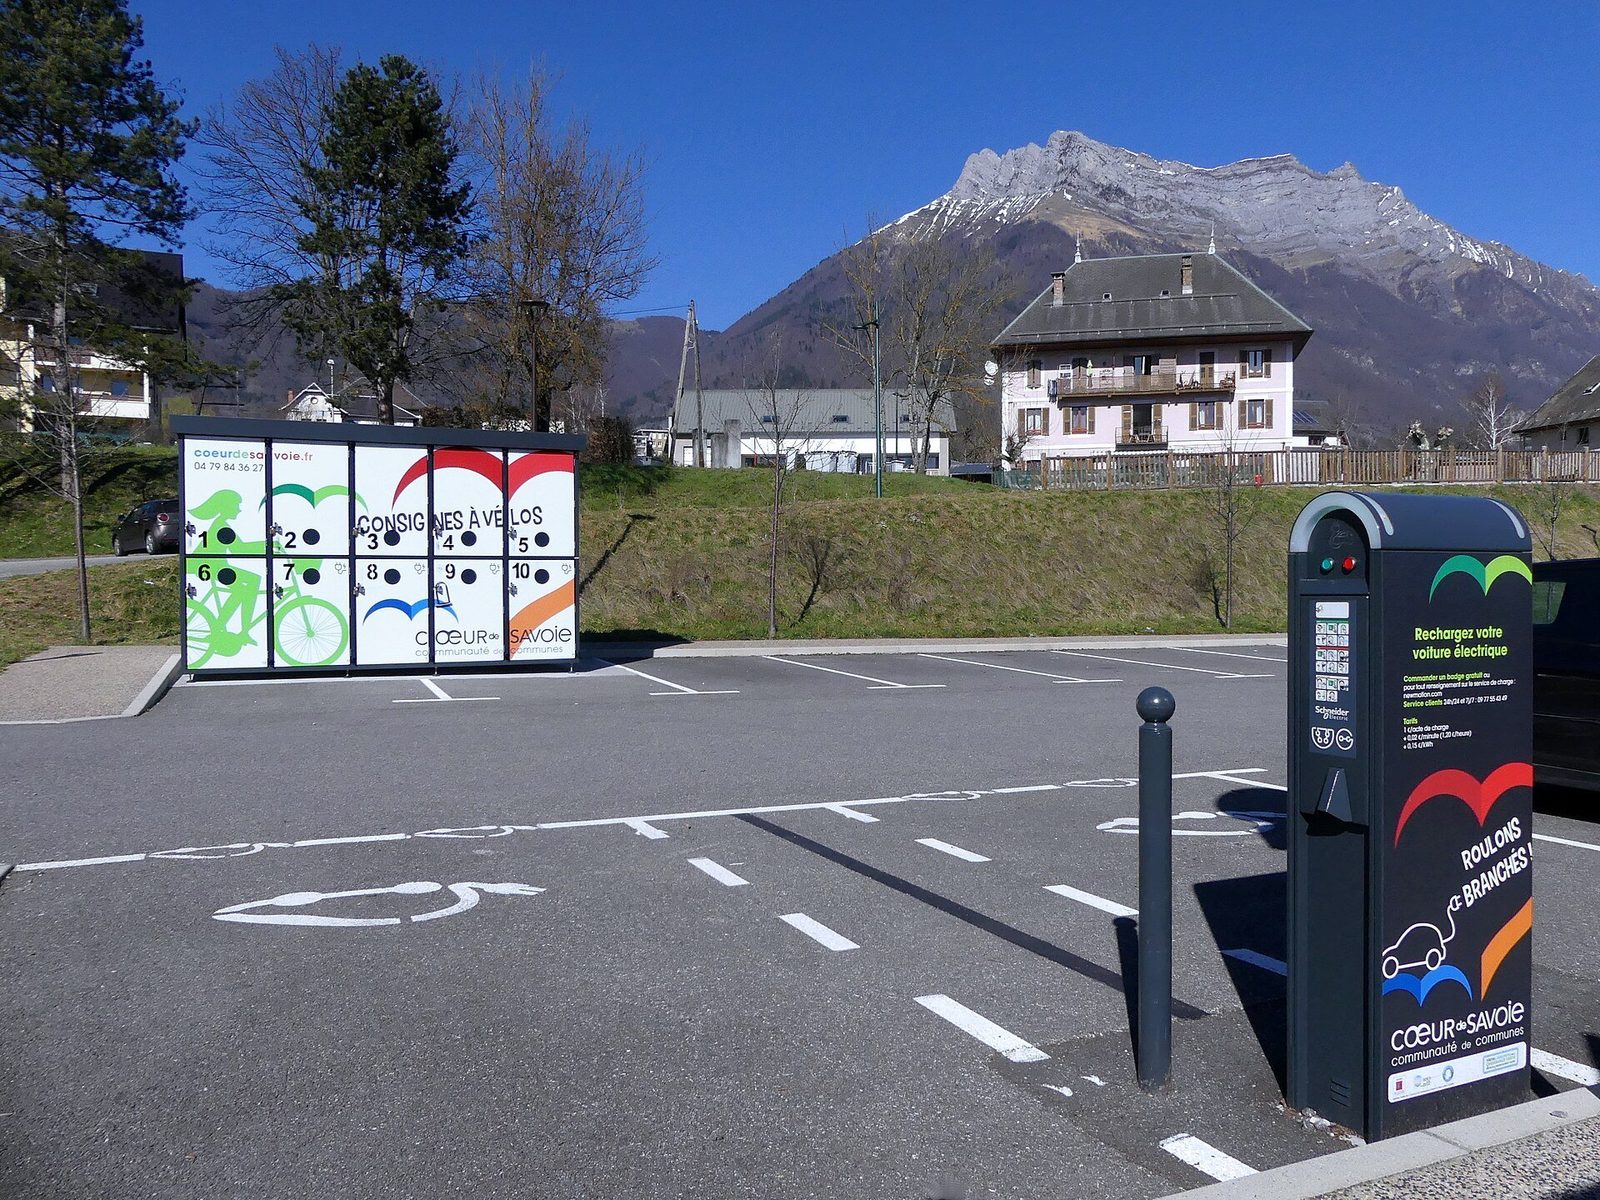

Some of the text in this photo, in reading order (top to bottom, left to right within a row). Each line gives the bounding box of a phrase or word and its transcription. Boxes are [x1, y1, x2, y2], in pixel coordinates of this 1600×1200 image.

[194, 462, 264, 472] 04 79 84 36 27
[469, 506, 480, 530] À
[198, 531, 208, 548] 1
[284, 531, 296, 549] 2
[367, 533, 378, 550] 3
[442, 534, 454, 550] 4
[518, 537, 528, 552] 5
[198, 564, 211, 582] 6
[283, 564, 295, 580] 7
[366, 564, 378, 580] 8
[445, 563, 456, 580] 9
[512, 562, 530, 579] 10
[488, 632, 500, 640] de
[1414, 626, 1503, 642] Rechargez votre
[510, 646, 563, 654] communes
[1412, 644, 1508, 660] voiture électrique
[1447, 673, 1464, 681] badge
[1466, 672, 1483, 680] gratuit
[1426, 681, 1461, 690] renseignement
[1314, 705, 1350, 716] Schneider
[1460, 816, 1522, 870] ROULONS
[1462, 842, 1533, 908] BRANCHÉS !
[1456, 1020, 1467, 1032] de
[1391, 1026, 1524, 1066] communauté de communes
